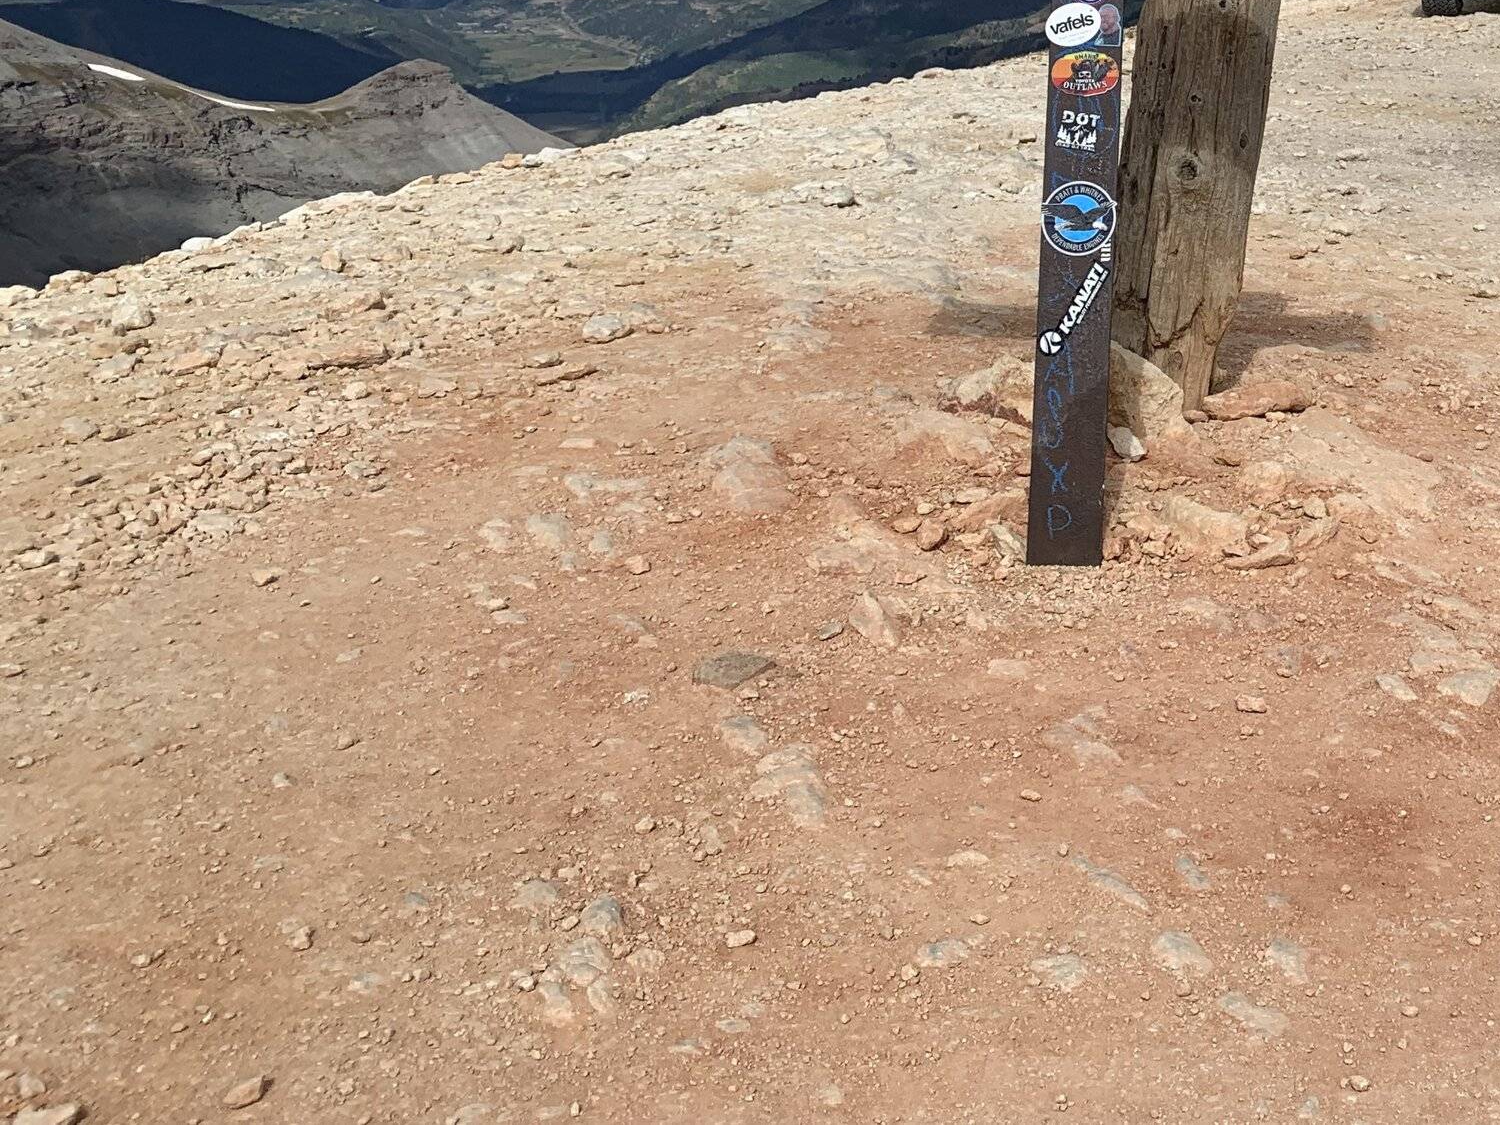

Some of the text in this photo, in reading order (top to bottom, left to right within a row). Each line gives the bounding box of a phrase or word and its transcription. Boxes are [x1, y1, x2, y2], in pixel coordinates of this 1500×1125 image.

[1050, 13, 1094, 35] vafels
[1063, 80, 1108, 91] OUTLAWS
[1061, 110, 1101, 128] DOT
[1054, 186, 1074, 202] PRATT
[1080, 186, 1106, 202] WHITNEY
[1060, 262, 1105, 335] KANATI
